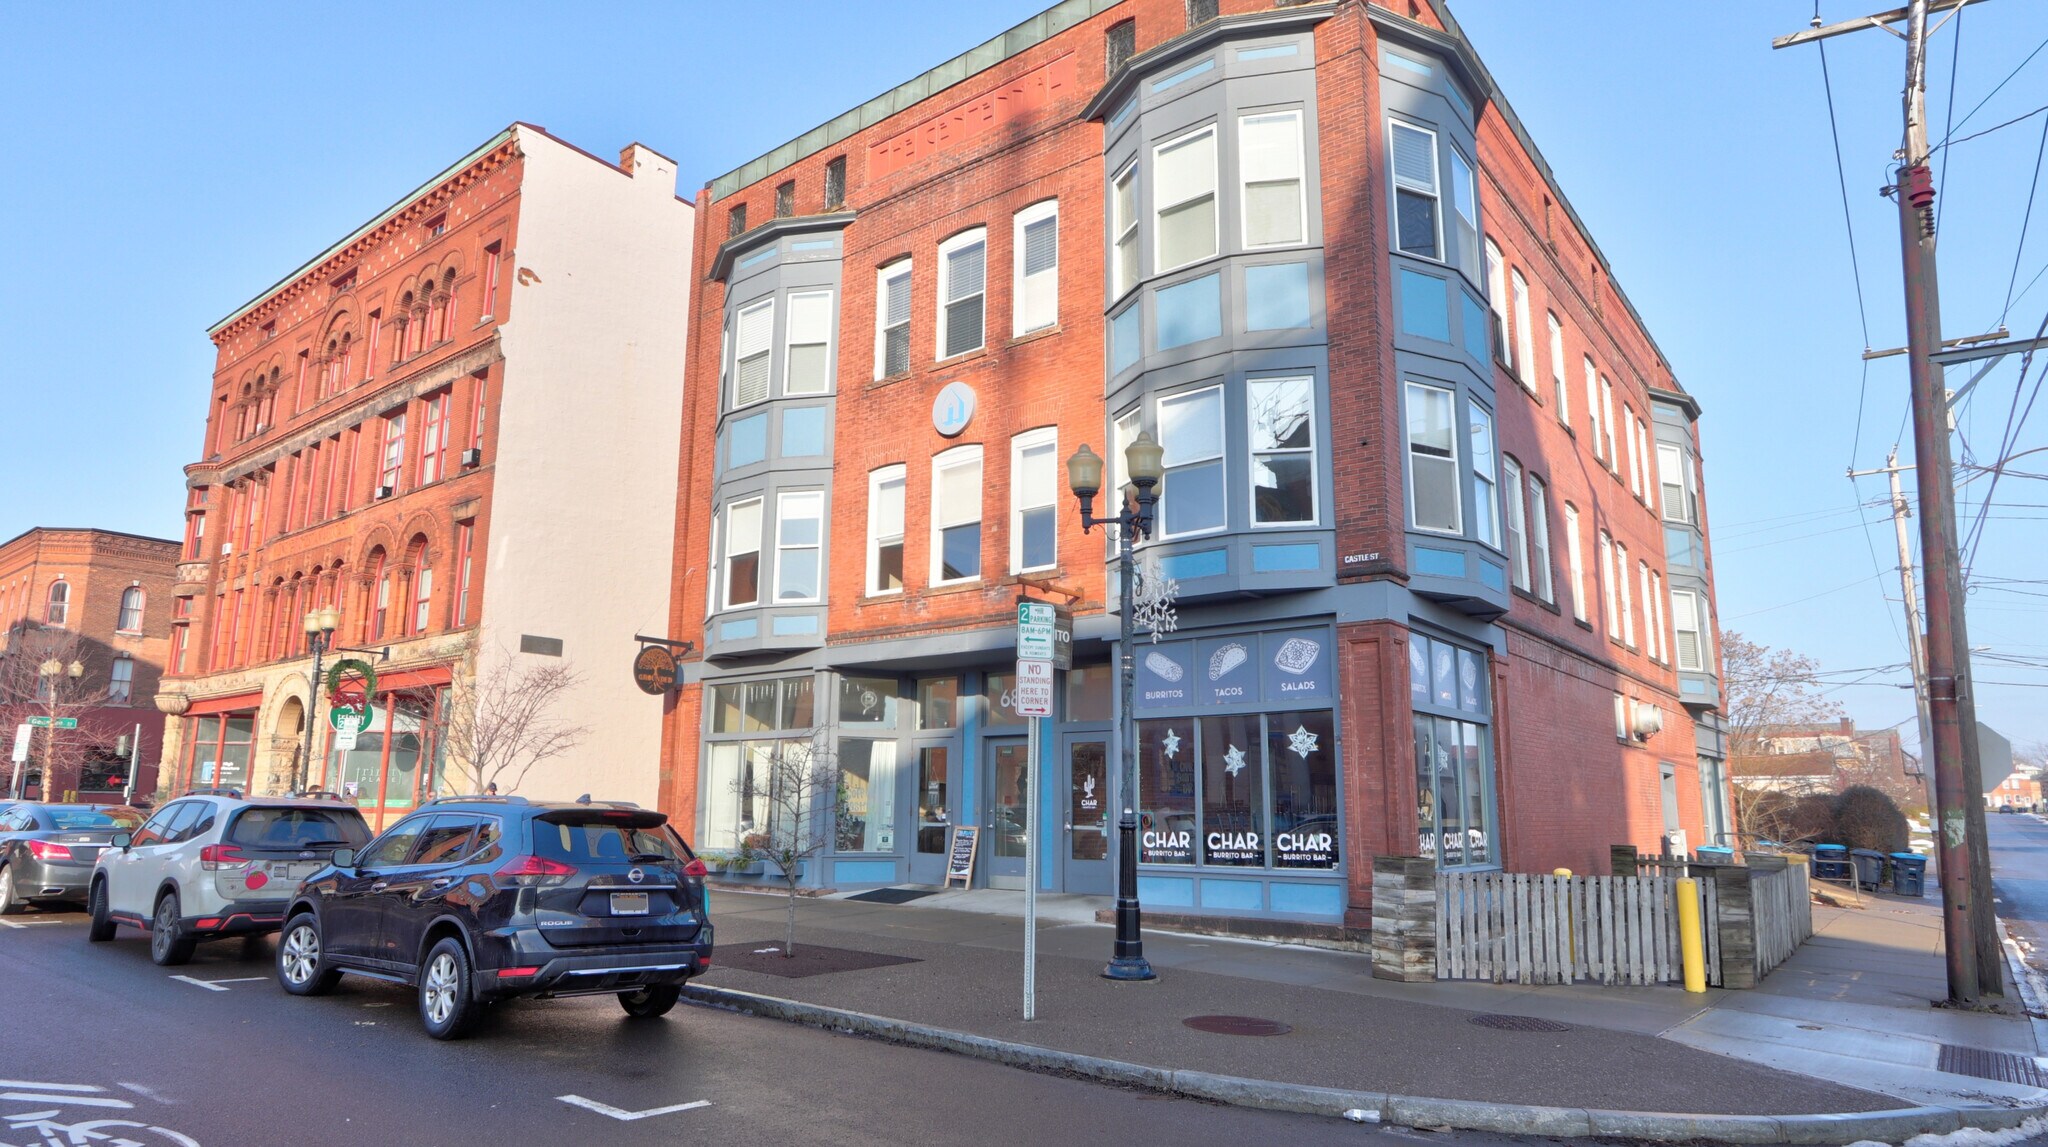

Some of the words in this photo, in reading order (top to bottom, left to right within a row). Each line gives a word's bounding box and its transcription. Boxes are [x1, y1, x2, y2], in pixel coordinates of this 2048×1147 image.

[878, 137, 915, 165] THE
[926, 68, 1062, 145] CENTENNIAL
[1344, 554, 1369, 563] CASTLE
[1021, 607, 1028, 621] 2
[1028, 665, 1041, 674] NO
[1214, 687, 1243, 697] TACOS
[1281, 680, 1316, 692] SALADS
[1021, 697, 1048, 705] CORNER
[1145, 689, 1184, 700] BURRITOS
[1143, 831, 1190, 849] CHAR
[1207, 832, 1259, 850] CHAR
[1277, 833, 1332, 852] CHAR
[1419, 832, 1436, 851] HAR
[1443, 832, 1463, 850] CHAR
[1470, 831, 1488, 848] CHAR
[1213, 851, 1240, 859] BURRITO
[1282, 853, 1312, 861] BURRITO
